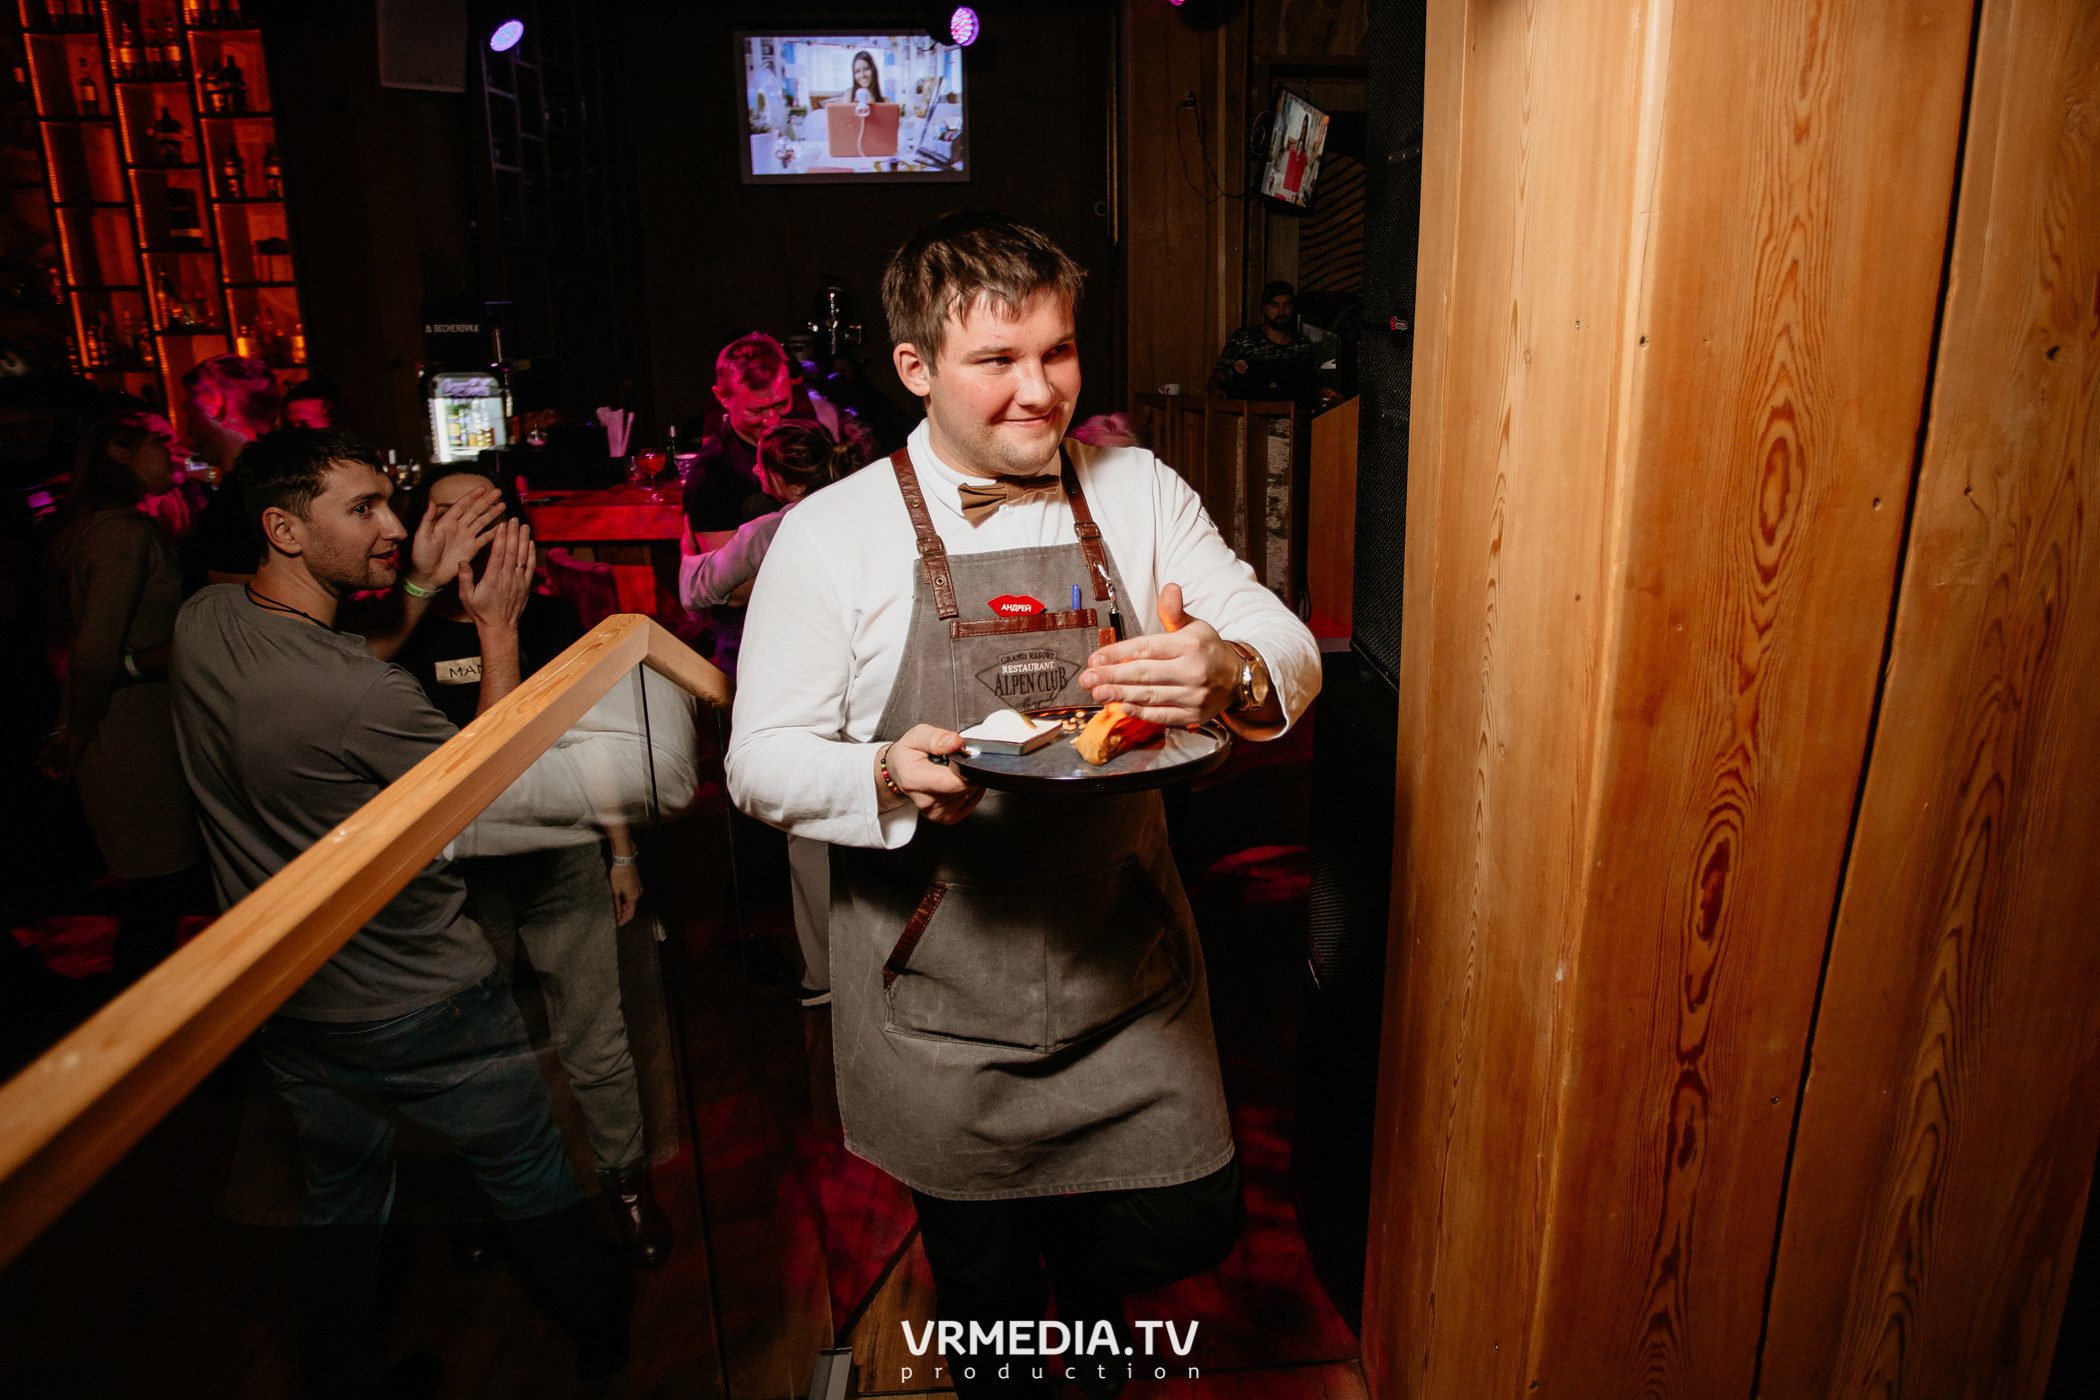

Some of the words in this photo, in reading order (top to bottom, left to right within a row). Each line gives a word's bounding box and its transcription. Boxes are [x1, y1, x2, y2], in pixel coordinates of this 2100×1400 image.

[1001, 603, 1032, 612] АНДРЕЙ
[1000, 653, 1027, 665] GRAND
[1029, 651, 1055, 660] RESORT
[1002, 661, 1055, 674] RESTAURANT
[994, 672, 1035, 697] ALPEN
[1037, 666, 1069, 692] CLUB
